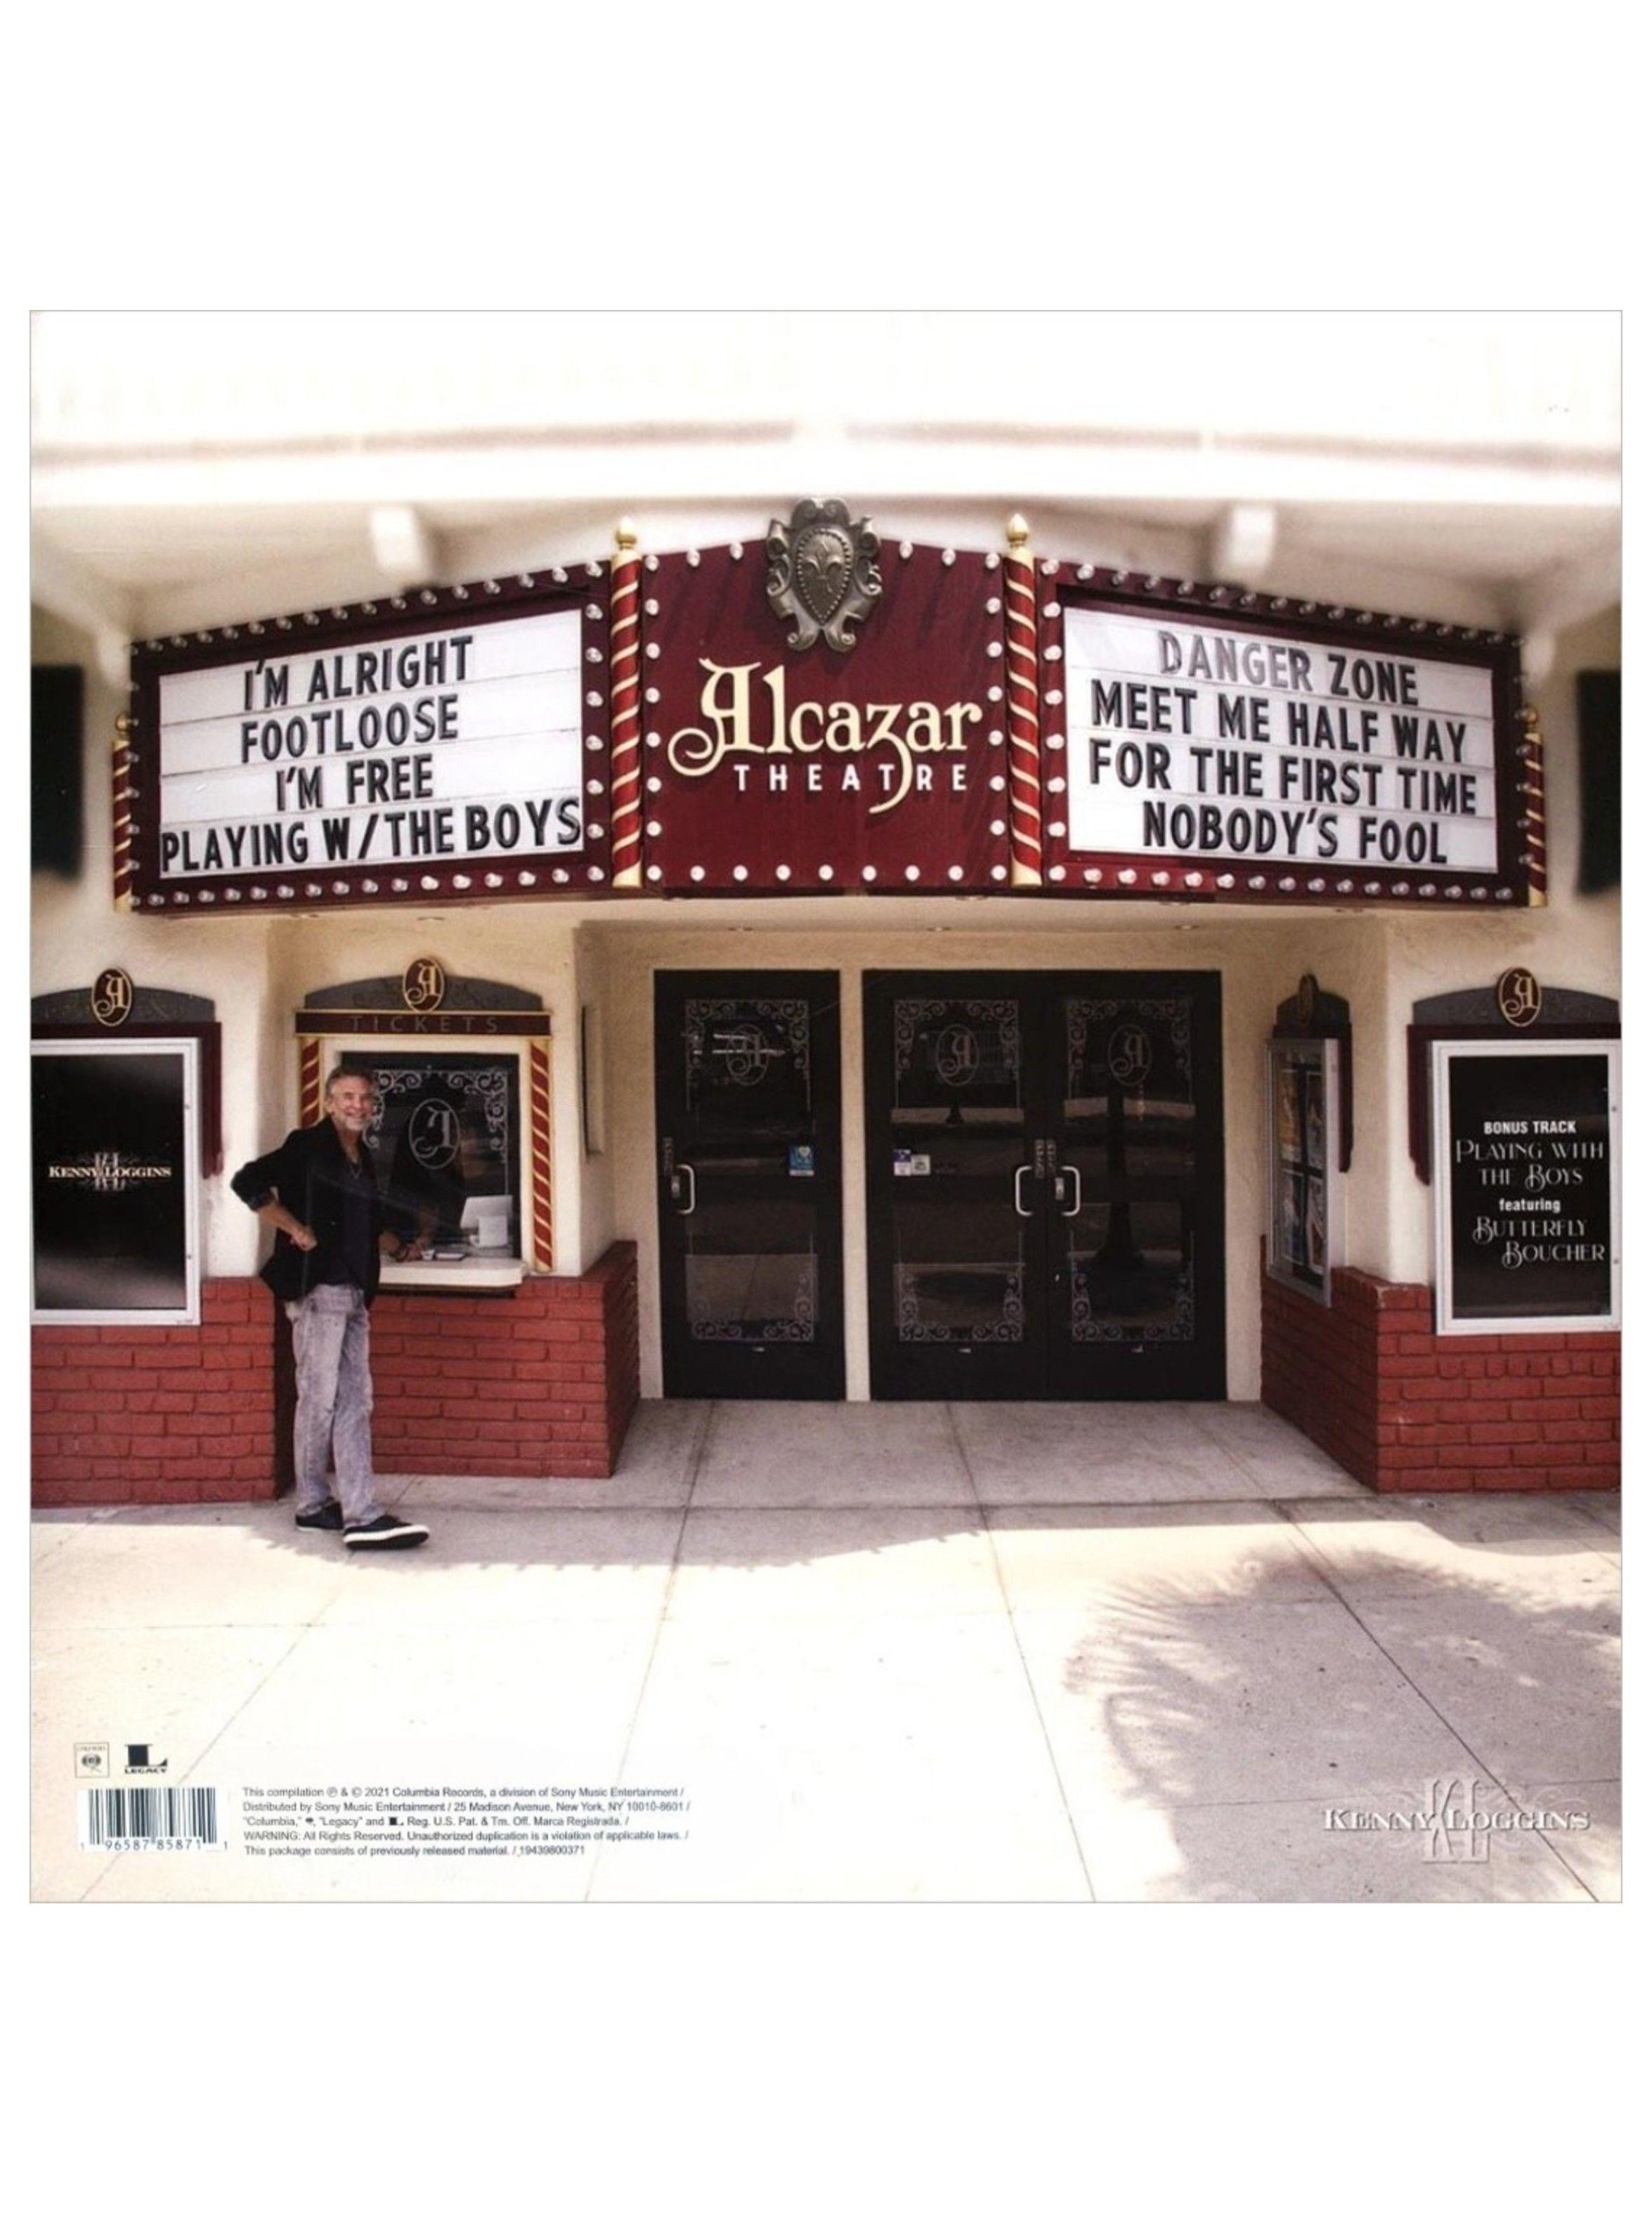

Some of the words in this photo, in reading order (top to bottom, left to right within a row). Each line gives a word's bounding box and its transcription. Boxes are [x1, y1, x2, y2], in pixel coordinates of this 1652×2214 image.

[244, 660, 288, 711] I'M
[308, 635, 473, 703] ALRIGHT
[1157, 630, 1312, 692] DANGER
[1327, 653, 1419, 706] ZONE
[241, 693, 458, 763] FOOTLOOSE
[1091, 679, 1197, 734] MEET
[1218, 692, 1270, 742] ME
[1287, 702, 1378, 753] HALF
[1391, 714, 1466, 763] WAY
[668, 657, 982, 814] Alcazar
[276, 765, 323, 811] I'M
[347, 753, 433, 804] FREE
[733, 764, 967, 791] THEATRE
[1089, 738, 1171, 789] FOR
[1190, 746, 1263, 797] THE
[1279, 755, 1382, 806] FIRST
[1397, 767, 1476, 815] TIME
[161, 821, 308, 872] PLAYING
[465, 796, 580, 851] BOYS
[1142, 801, 1338, 857] NOBODY'S
[1359, 819, 1446, 864] FOOL
[351, 1016, 499, 1033] TICKETS
[1483, 1122, 1528, 1134] BONUS
[1533, 1120, 1576, 1134] TRACK
[1456, 1139, 1542, 1163] PLAYING
[1552, 1141, 1604, 1158] WITH
[49, 1166, 99, 1178] KENNY
[105, 1166, 172, 1178] LOGGINS
[1480, 1168, 1515, 1185] THE
[1525, 1164, 1583, 1193] BOYS
[1499, 1198, 1561, 1214] featuring
[1472, 1216, 1587, 1244] BUTTERFLY
[1502, 1241, 1606, 1269] BOUCHER
[244, 1787, 264, 1796] This
[268, 1787, 323, 1798] compilation
[341, 1788, 348, 1797] &
[365, 1787, 389, 1797] 2021
[393, 1787, 440, 1797] Columbia
[443, 1787, 486, 1798] Records,
[499, 1788, 535, 1797] division
[539, 1788, 548, 1797] of
[552, 1787, 575, 1799] Sony
[579, 1787, 606, 1797] Music
[611, 1787, 677, 1797] Entertainment
[243, 1802, 297, 1811] Distributed
[300, 1802, 313, 1813] by
[315, 1802, 340, 1813] Sony
[344, 1802, 372, 1811] Music
[376, 1802, 445, 1811] Entertainment
[455, 1802, 466, 1811] 25
[469, 1802, 510, 1811] Madison
[513, 1802, 552, 1813] Avenue,
[557, 1802, 578, 1811] New
[581, 1802, 605, 1813] York,
[609, 1802, 623, 1811] NY
[366, 1817, 384, 1825] and
[408, 1816, 431, 1828] Reg.
[434, 1816, 455, 1825] U.S.
[459, 1816, 477, 1825] Pat.
[481, 1816, 488, 1825] &
[534, 1816, 564, 1825] Marca
[105, 1839, 150, 1851] 96587
[157, 1839, 202, 1851] 85871
[223, 1841, 228, 1851] 1
[244, 1831, 301, 1840] WARNING:
[304, 1832, 316, 1840] All
[319, 1832, 351, 1842] Rights
[354, 1831, 403, 1841] Reserved.
[408, 1832, 473, 1841] Unauthorized
[476, 1832, 528, 1842] duplication
[531, 1832, 538, 1840] is
[552, 1832, 590, 1840] violation
[594, 1831, 604, 1839] of
[606, 1831, 654, 1842] applicable
[246, 1846, 266, 1854] This
[269, 1846, 311, 1856] package
[315, 1846, 354, 1855] consists
[358, 1846, 368, 1855] of
[370, 1846, 419, 1856] previously
[423, 1846, 464, 1856] released
[468, 1846, 509, 1855] material.
